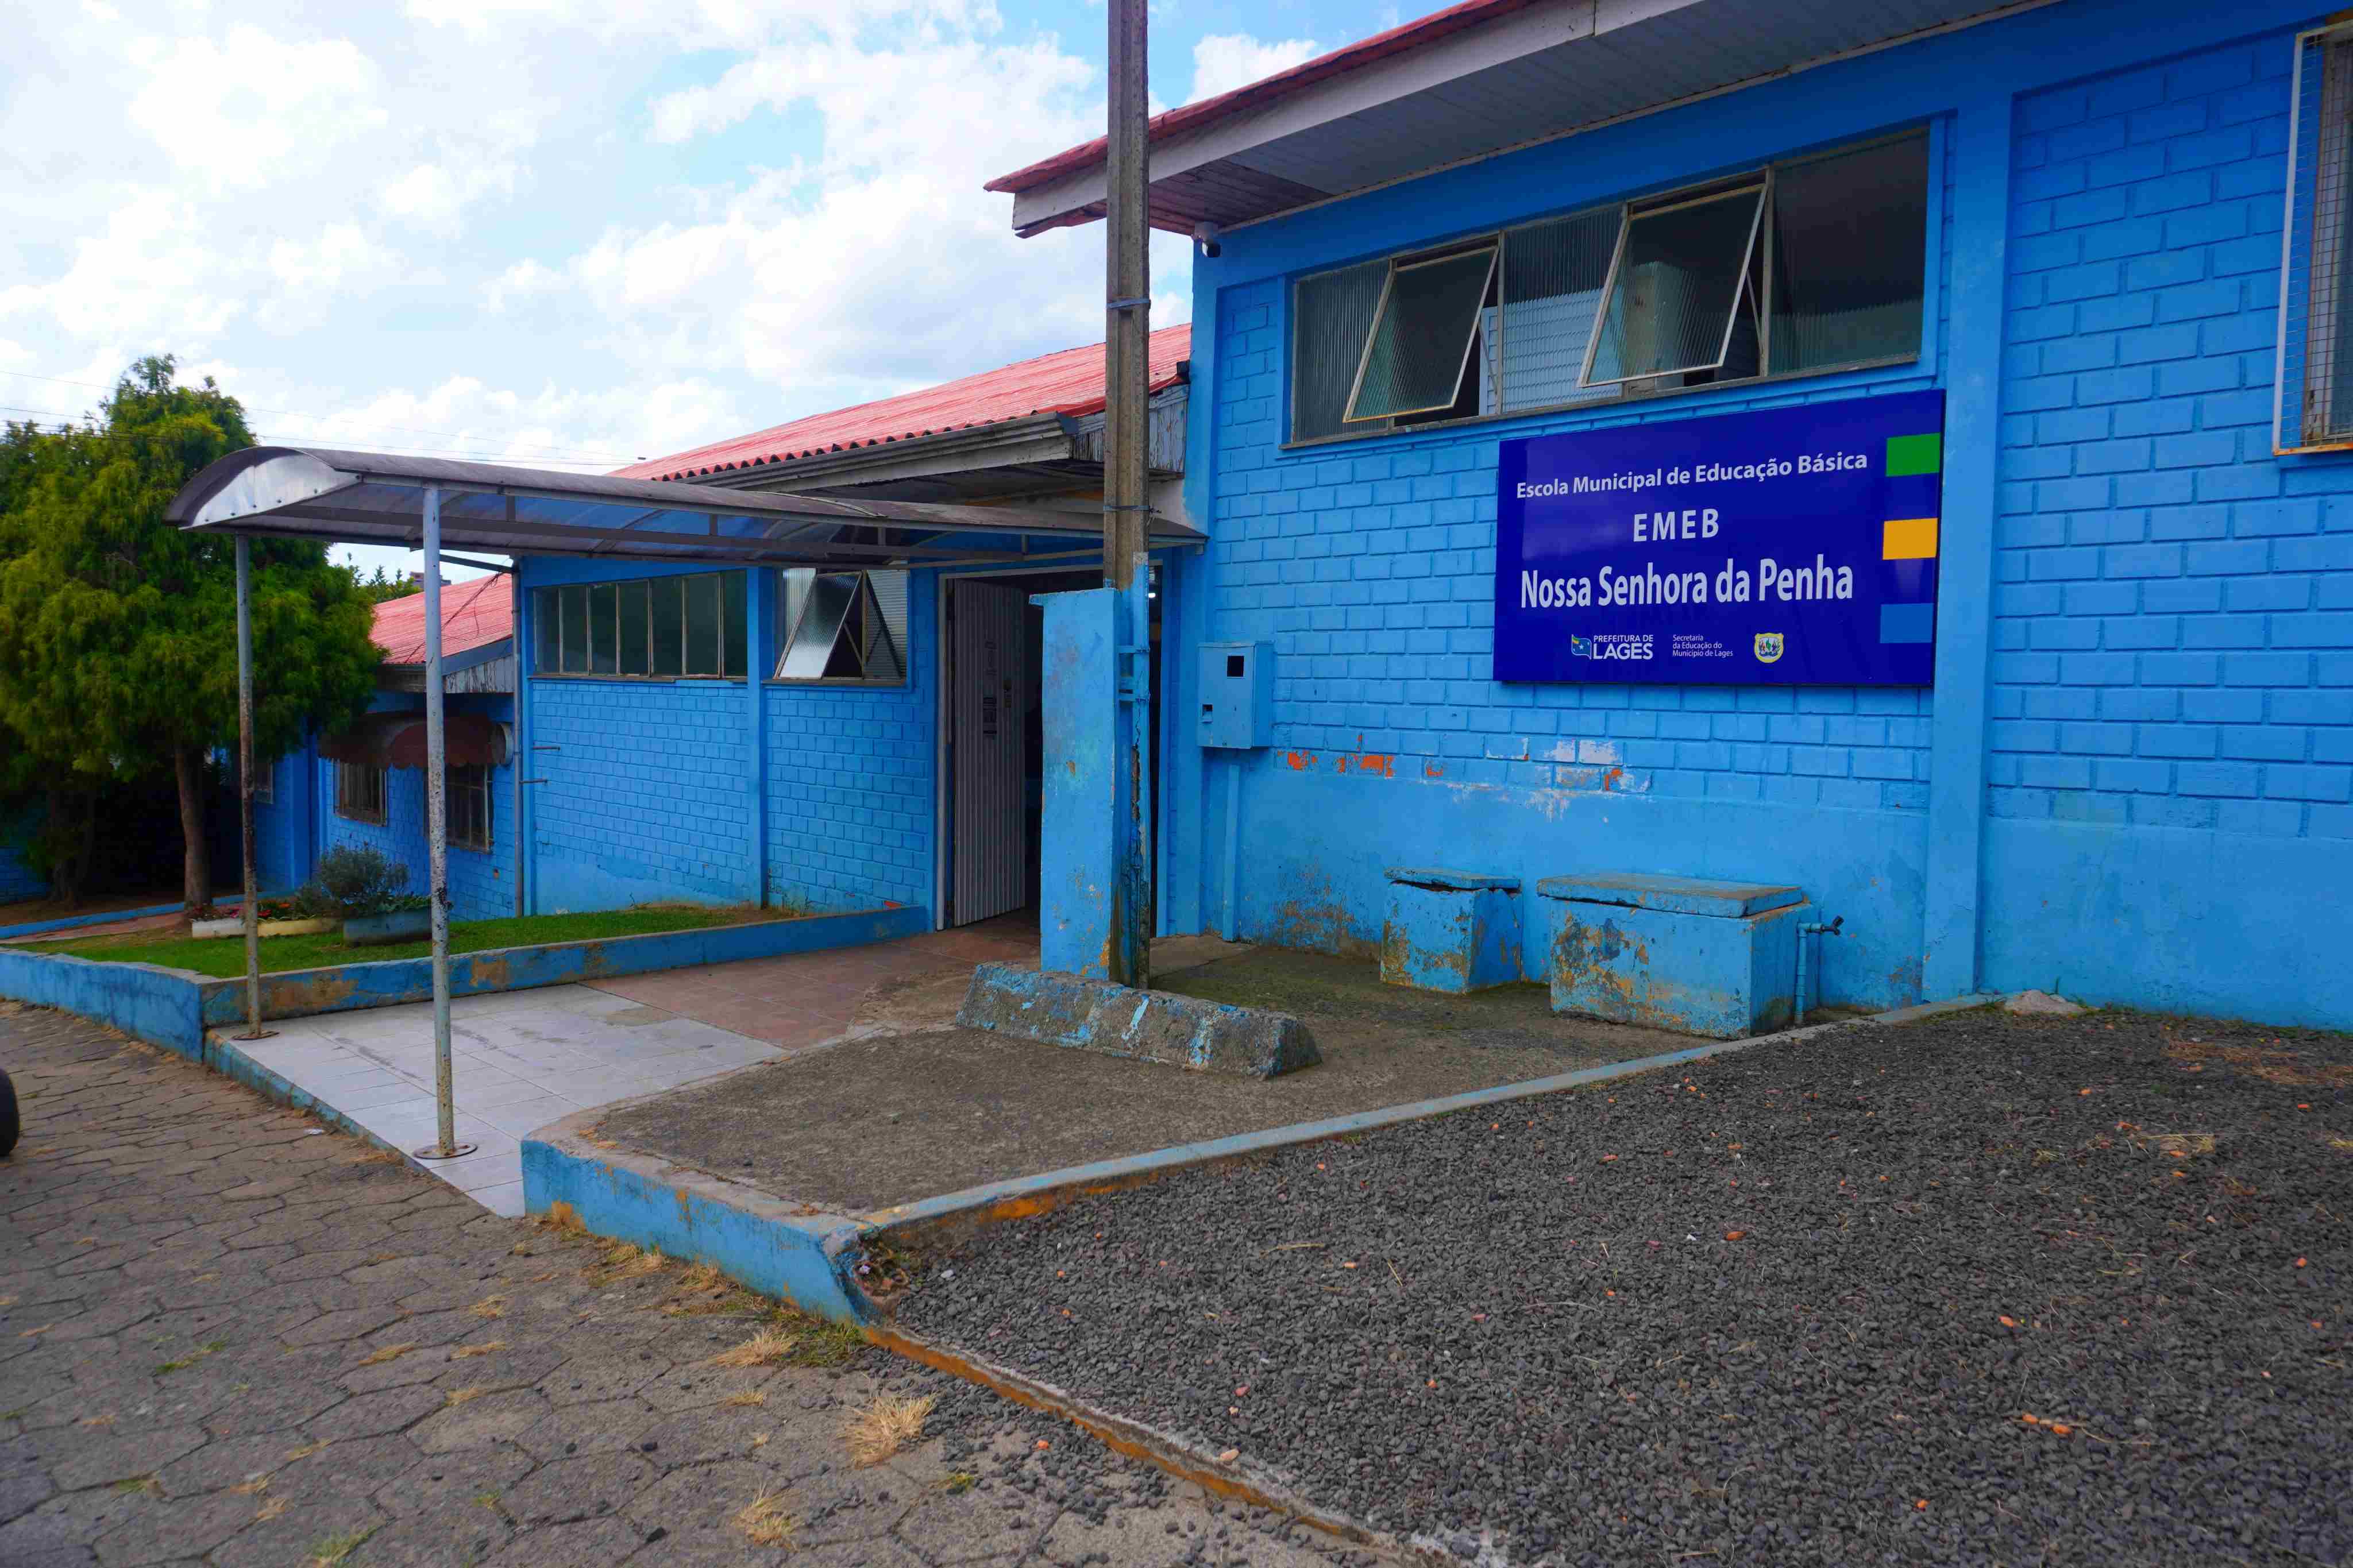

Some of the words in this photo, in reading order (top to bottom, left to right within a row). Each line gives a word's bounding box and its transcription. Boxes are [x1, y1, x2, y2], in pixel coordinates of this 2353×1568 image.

[1517, 480, 1569, 499] Escola
[1572, 468, 1661, 495] Municipal
[1666, 466, 1691, 485] de
[1695, 457, 1792, 484] Educação
[1797, 450, 1868, 475] Básica
[1633, 508, 1719, 543] EMEB
[1521, 569, 1591, 609] Nossa
[1598, 561, 1708, 605] Senhora
[1715, 558, 1751, 603] da
[1758, 553, 1854, 602] Penha
[1593, 643, 1654, 660] LAGES
[1594, 634, 1639, 643] PREFEITURA
[1642, 634, 1654, 642] DE
[1681, 642, 1712, 650] Educação
